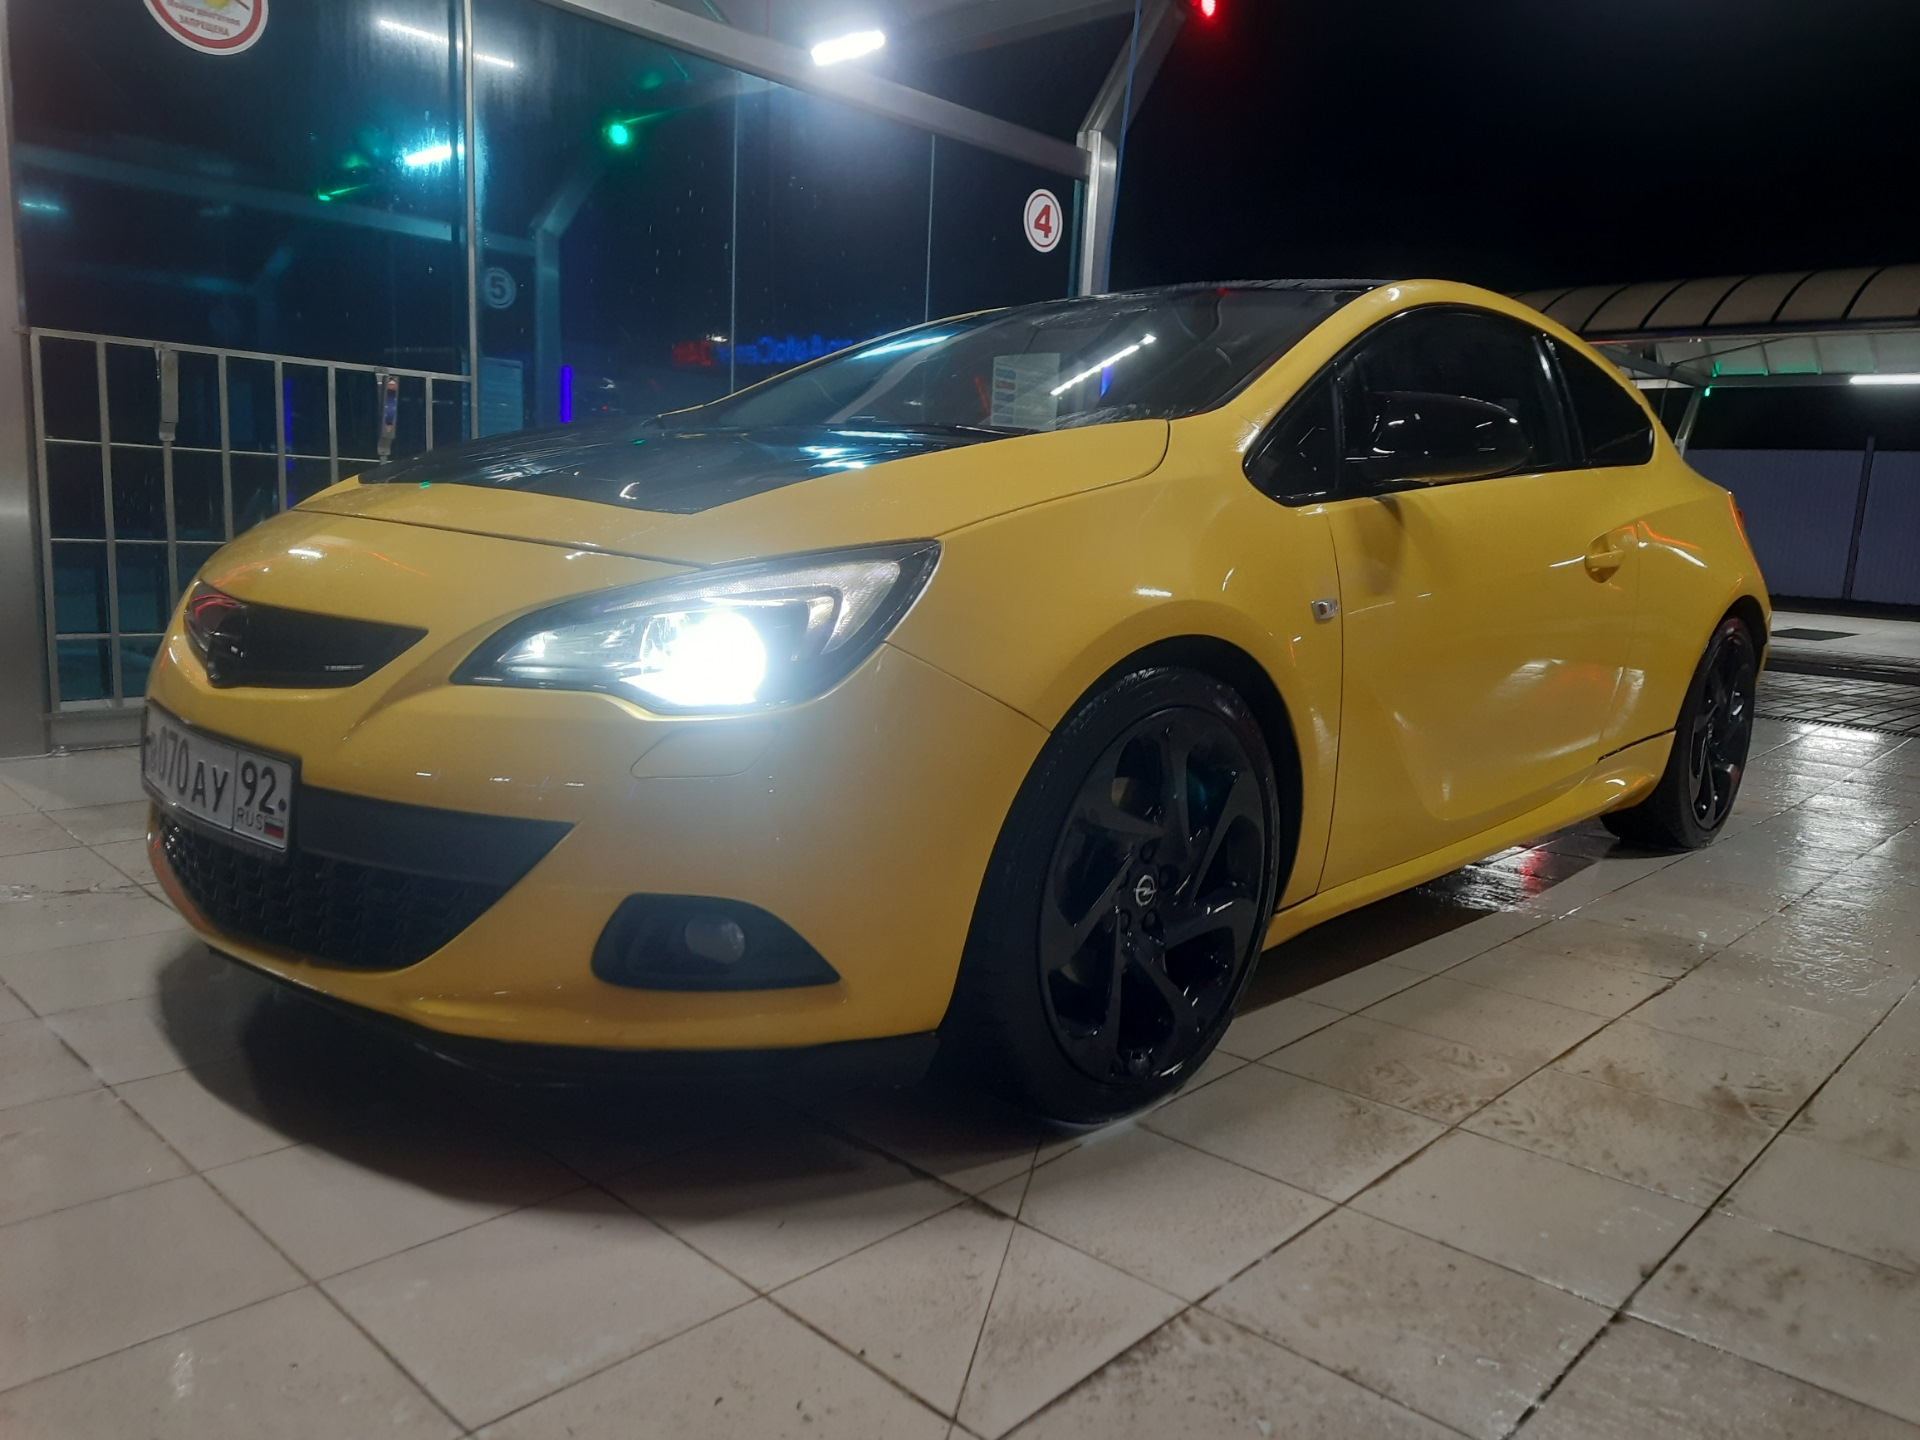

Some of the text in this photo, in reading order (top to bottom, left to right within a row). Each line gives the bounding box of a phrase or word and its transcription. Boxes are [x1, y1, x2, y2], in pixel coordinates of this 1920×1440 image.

[179, 14, 230, 36] ЗАПРЕЩЕНА
[1034, 204, 1052, 239] 4
[490, 276, 507, 301] 5
[241, 760, 276, 815] 92
[236, 807, 265, 831] RUS
